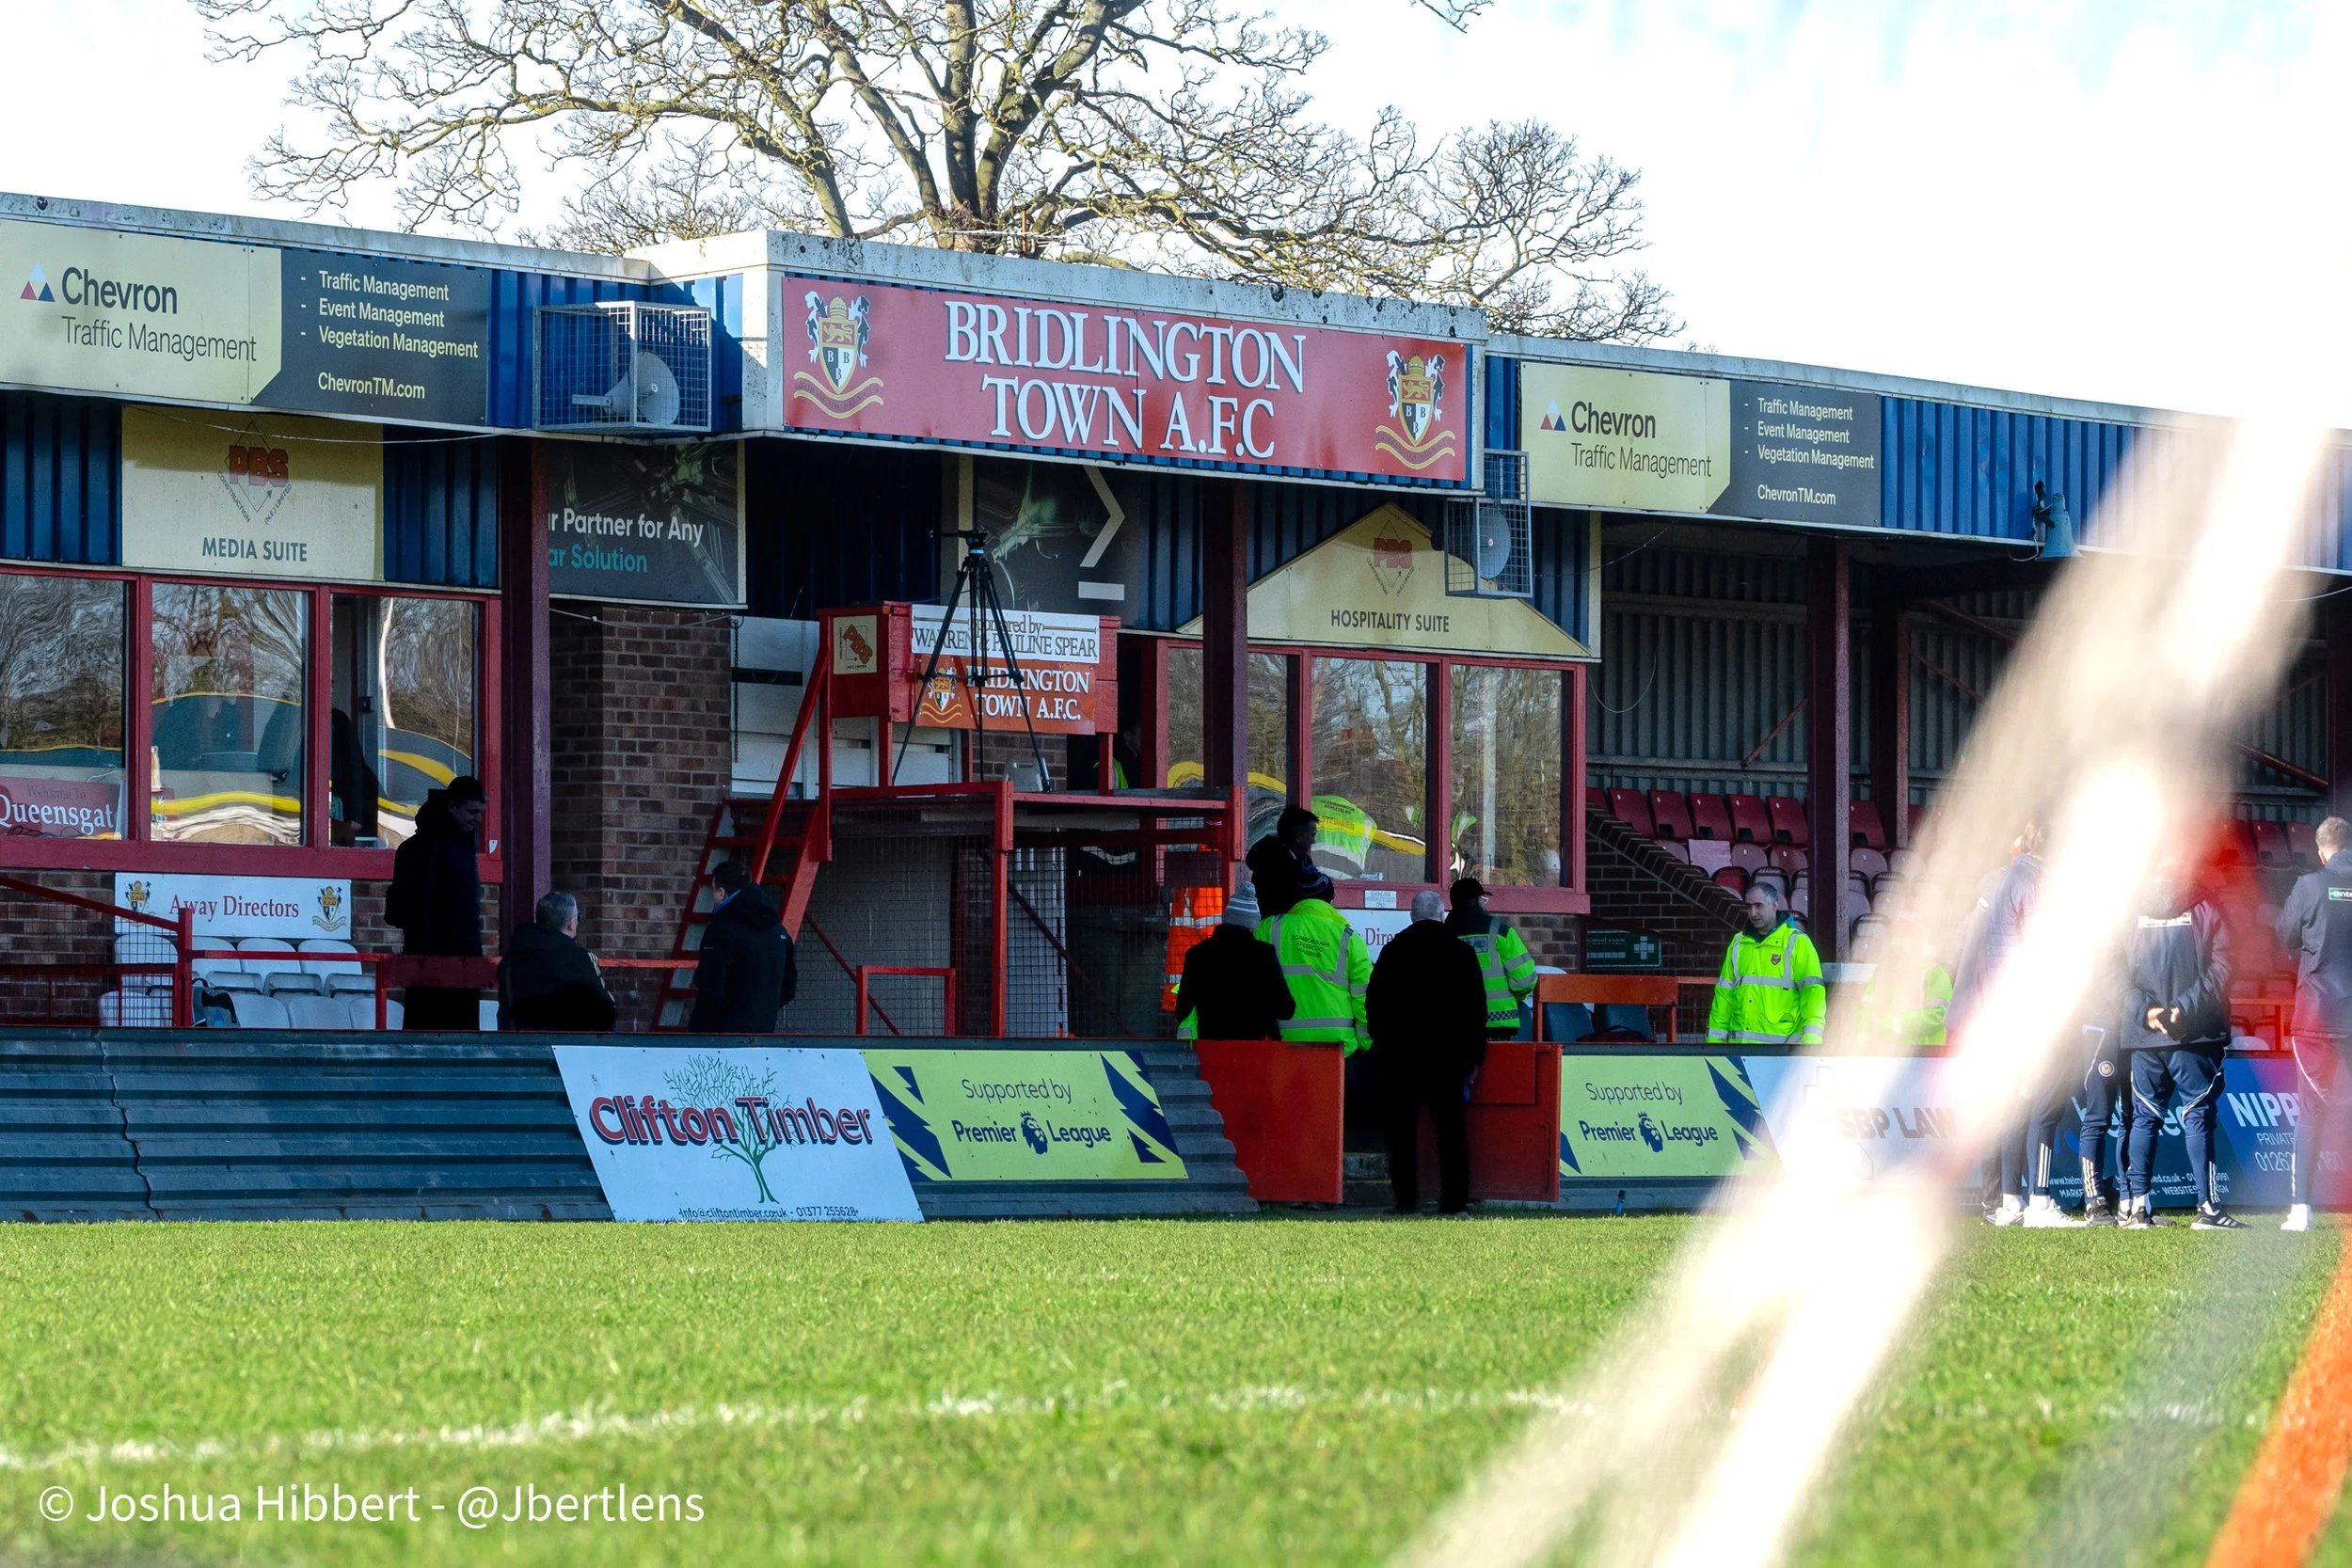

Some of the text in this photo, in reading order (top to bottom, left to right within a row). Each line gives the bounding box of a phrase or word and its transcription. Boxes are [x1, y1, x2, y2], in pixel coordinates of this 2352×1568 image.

[61, 266, 178, 315] Chevron
[318, 270, 449, 301] Traffic Management
[318, 298, 445, 328] Event Management
[62, 316, 257, 363] Traffic Management
[318, 325, 479, 359] Vegetation Management
[945, 301, 1306, 393] BRIDLINGTON
[317, 372, 425, 401] ChevronTM.com
[981, 375, 1275, 458] TOWN A.F.C
[1571, 401, 1656, 438] Chevron
[1757, 397, 1853, 421] Traffic Management
[1757, 422, 1850, 444] Event Management
[230, 445, 289, 487] PBS
[1571, 443, 1711, 479] Traffic Management
[1757, 445, 1874, 470] Vegetation Management
[217, 470, 250, 523] CONSTRUCTION
[1757, 484, 1836, 505] ChevronTM.com
[564, 508, 633, 537] Partner
[638, 513, 663, 538] for
[668, 516, 704, 547] Any
[202, 537, 307, 562] MEDIA SUITE
[571, 544, 647, 573] Solution
[1028, 614, 1042, 639] by
[1331, 610, 1450, 633] HOSPITALITY SUITE
[993, 633, 1052, 654] PULINE
[1055, 637, 1097, 657] SPEAR
[1037, 697, 1081, 721] A.F.C.
[26, 784, 87, 800] Welcome To
[0, 794, 115, 835] Queensgat
[169, 895, 299, 922] Away Directors
[961, 1078, 1073, 1104] Supported by
[1585, 1083, 1683, 1105] Supported by
[590, 1095, 873, 1146] Clifton Timber
[951, 1119, 1112, 1148] Premier League
[1579, 1120, 1719, 1147] Premier League
[1835, 1106, 1957, 1139] SBP LAW
[797, 1207, 822, 1217] 01377
[824, 1206, 857, 1216] 255628
